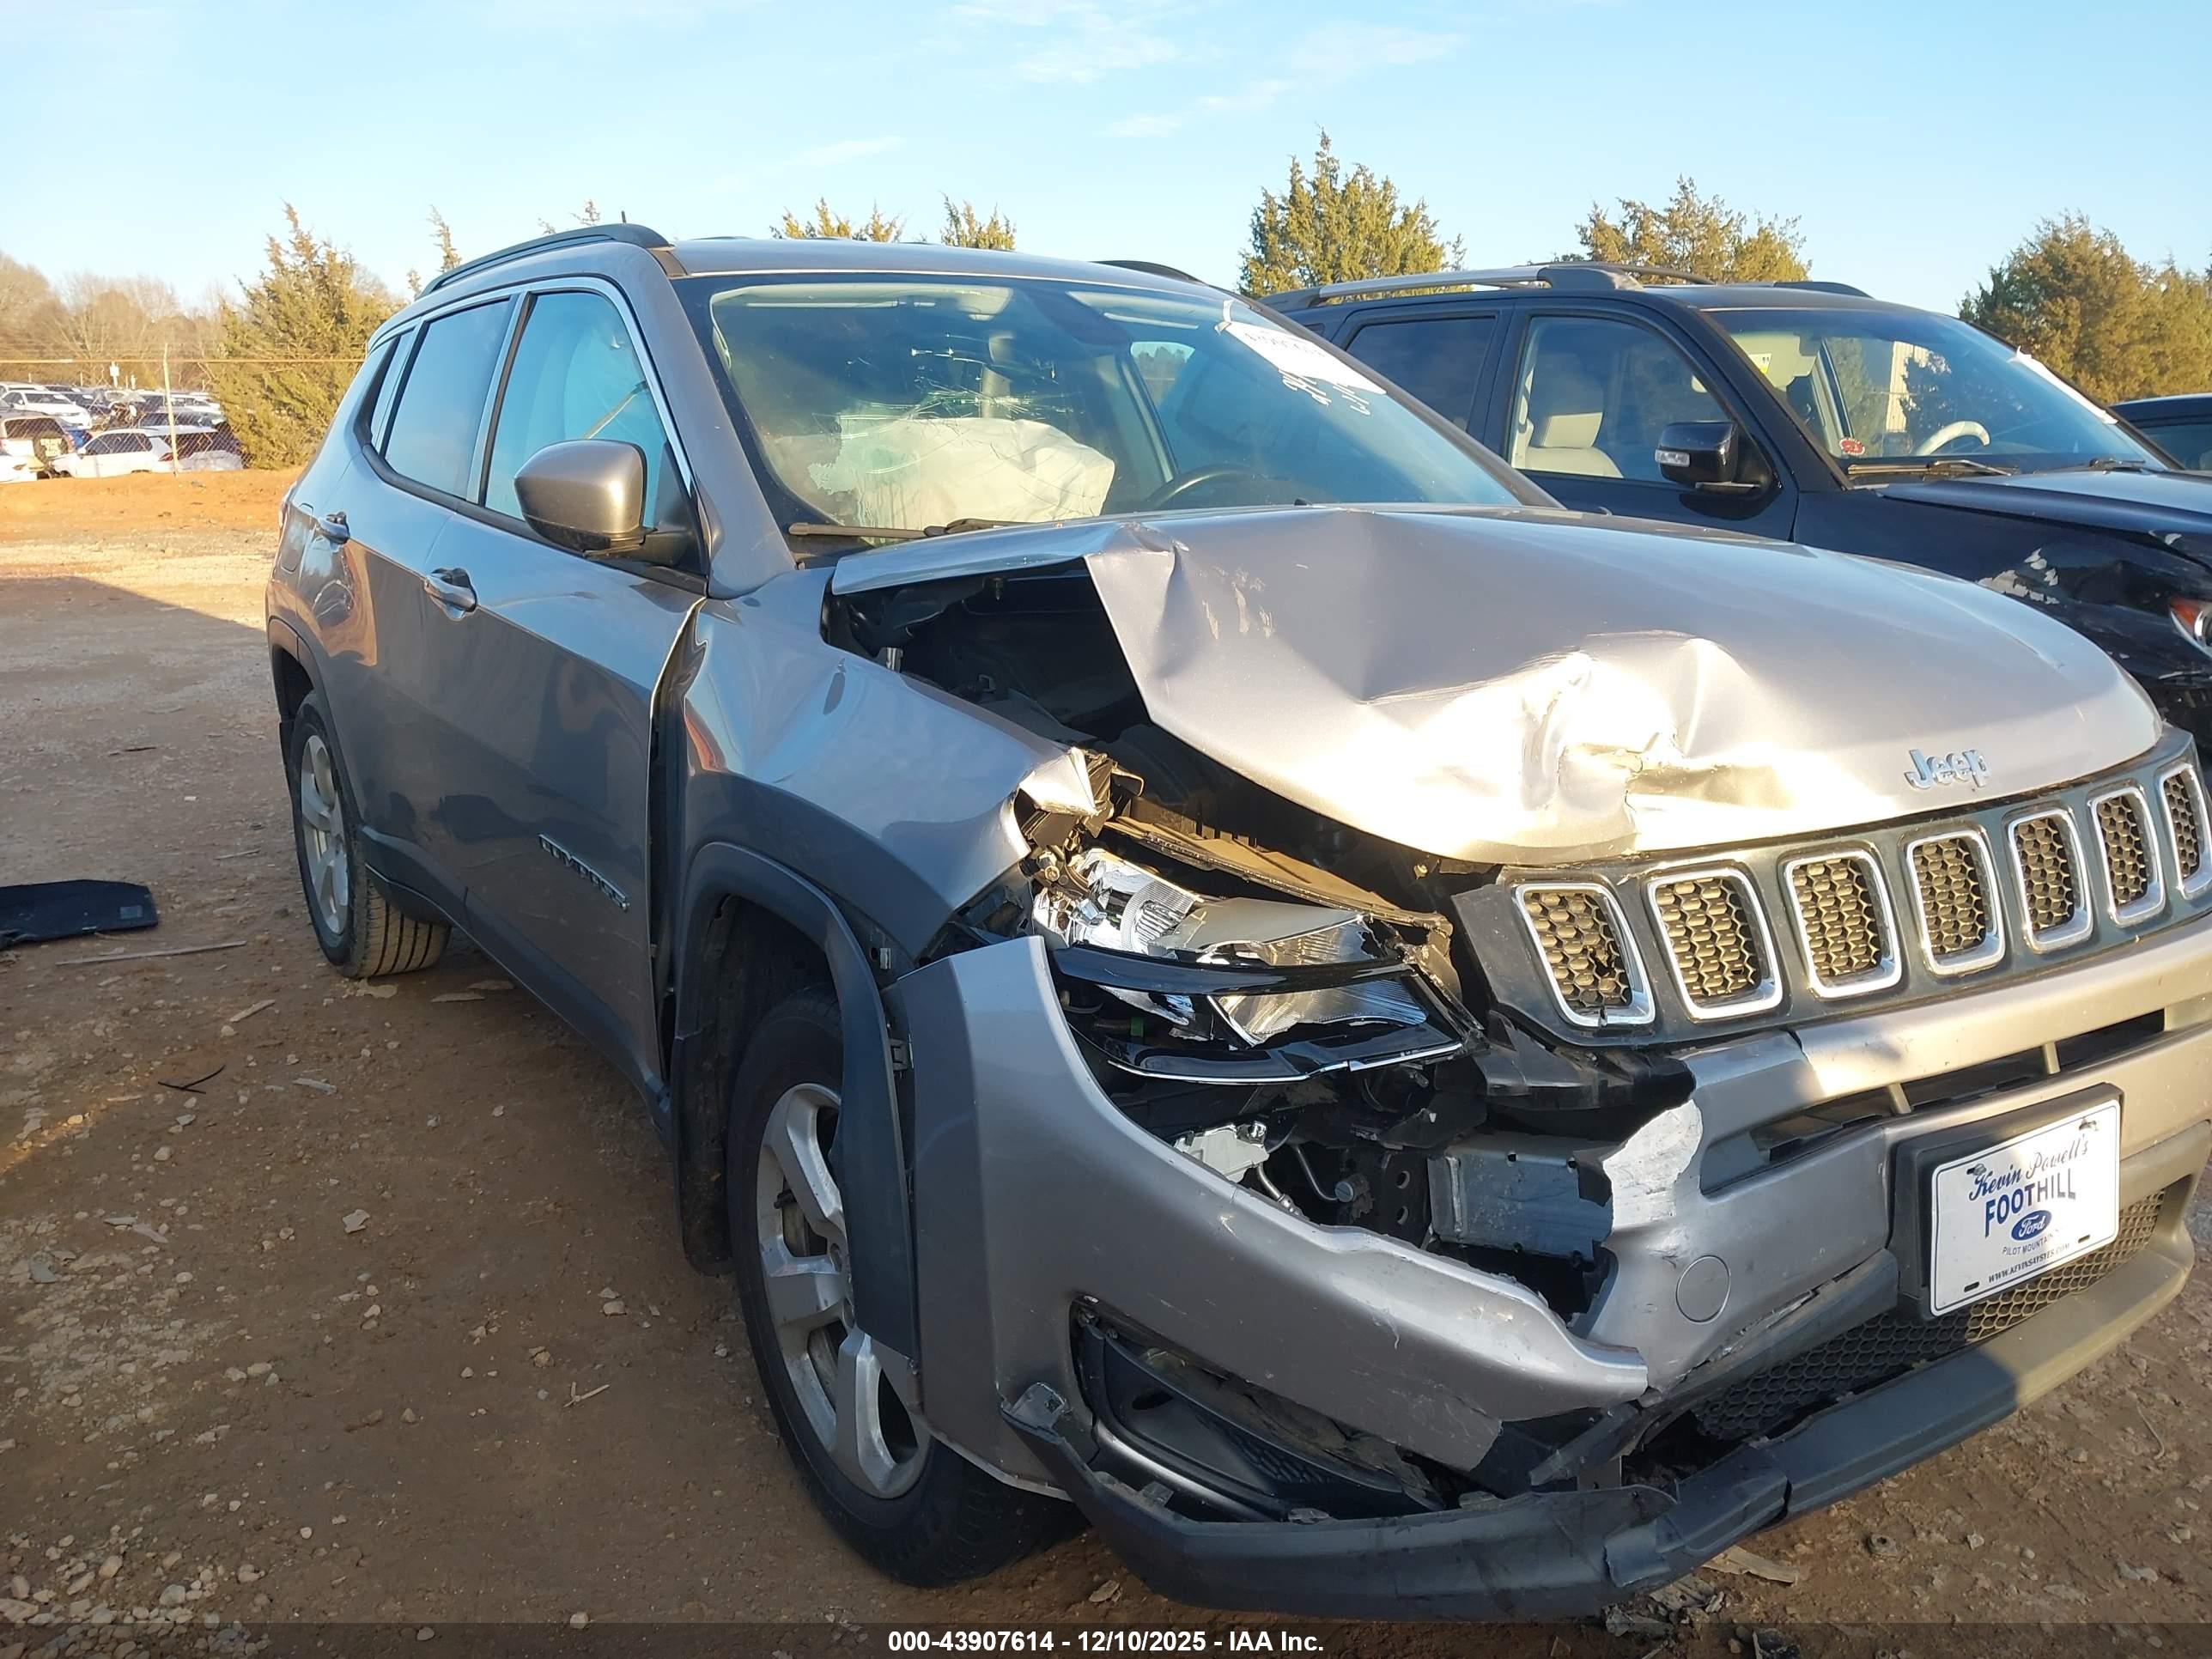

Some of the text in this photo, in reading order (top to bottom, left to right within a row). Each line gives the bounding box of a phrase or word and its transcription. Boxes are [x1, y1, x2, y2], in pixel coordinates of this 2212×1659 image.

[1904, 749, 1990, 790] Jeep
[1969, 1133, 2089, 1200] Kevin Powell's
[1984, 1169, 2076, 1238] FOOTHILL
[2019, 1212, 2046, 1236] Ford
[2002, 1245, 2021, 1255] PILOT
